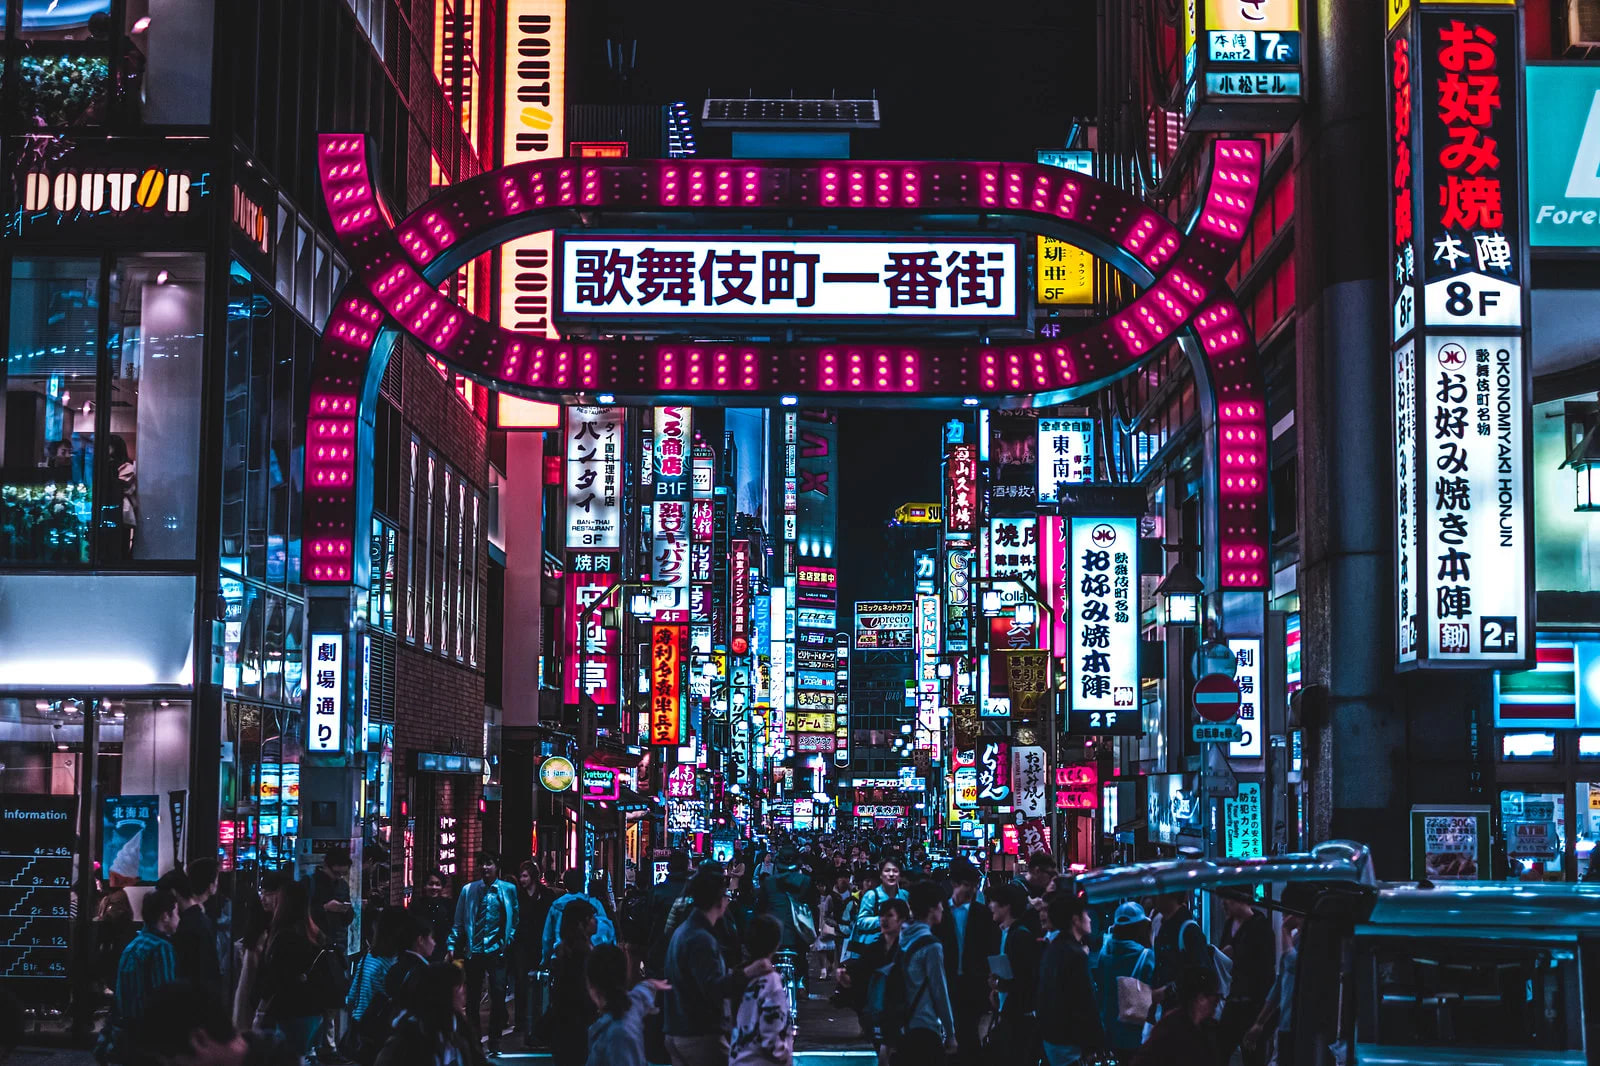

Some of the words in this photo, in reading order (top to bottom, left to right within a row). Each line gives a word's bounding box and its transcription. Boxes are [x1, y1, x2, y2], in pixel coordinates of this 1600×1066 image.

[1214, 34, 1247, 48] 本陣
[1260, 33, 1290, 60] 7F
[516, 15, 553, 152] DOUTOR
[1219, 75, 1286, 93] 小松ビル
[1438, 19, 1503, 230] お好み焼
[25, 169, 191, 212] DOUTOR
[1535, 205, 1600, 225] Fore
[1432, 231, 1512, 273] 本陣
[575, 248, 1004, 308] 歌舞伎町一番街
[1044, 288, 1064, 299] 5F
[1445, 281, 1501, 316] 8F
[1399, 294, 1413, 328] 8F
[1041, 324, 1061, 337] 4F
[1475, 349, 1491, 437] 歌舞伎町名物
[1496, 349, 1512, 474] OKONOMIYAKI
[1041, 421, 1092, 431] 全卓全自動
[574, 421, 601, 513] バンタイ
[604, 422, 615, 507] タイ国料理専門店
[657, 482, 687, 495] B1F
[1435, 372, 1472, 620] お好み焼き本陣
[1498, 479, 1513, 547] HONJIN
[582, 534, 603, 544] 3F
[575, 554, 610, 571] 焼肉
[660, 611, 681, 622] 4F
[1080, 549, 1111, 698] お好み焼本陣
[1483, 622, 1516, 647] 2F
[316, 642, 337, 742] 劇場通り
[1236, 649, 1255, 746] 劇場通り
[798, 719, 821, 729] ゲーム
[1090, 712, 1117, 727] 2F
[1196, 727, 1240, 739] 自転車を除く
[4, 809, 67, 820] information
[113, 807, 149, 819] 北海道
[55, 847, 71, 855] 46
[32, 877, 43, 885] 3F
[53, 877, 69, 885] 47
[31, 907, 42, 915] 2F
[52, 907, 67, 915] 53
[32, 937, 41, 945] 1F
[51, 937, 67, 945] 12
[50, 963, 65, 971] 45
